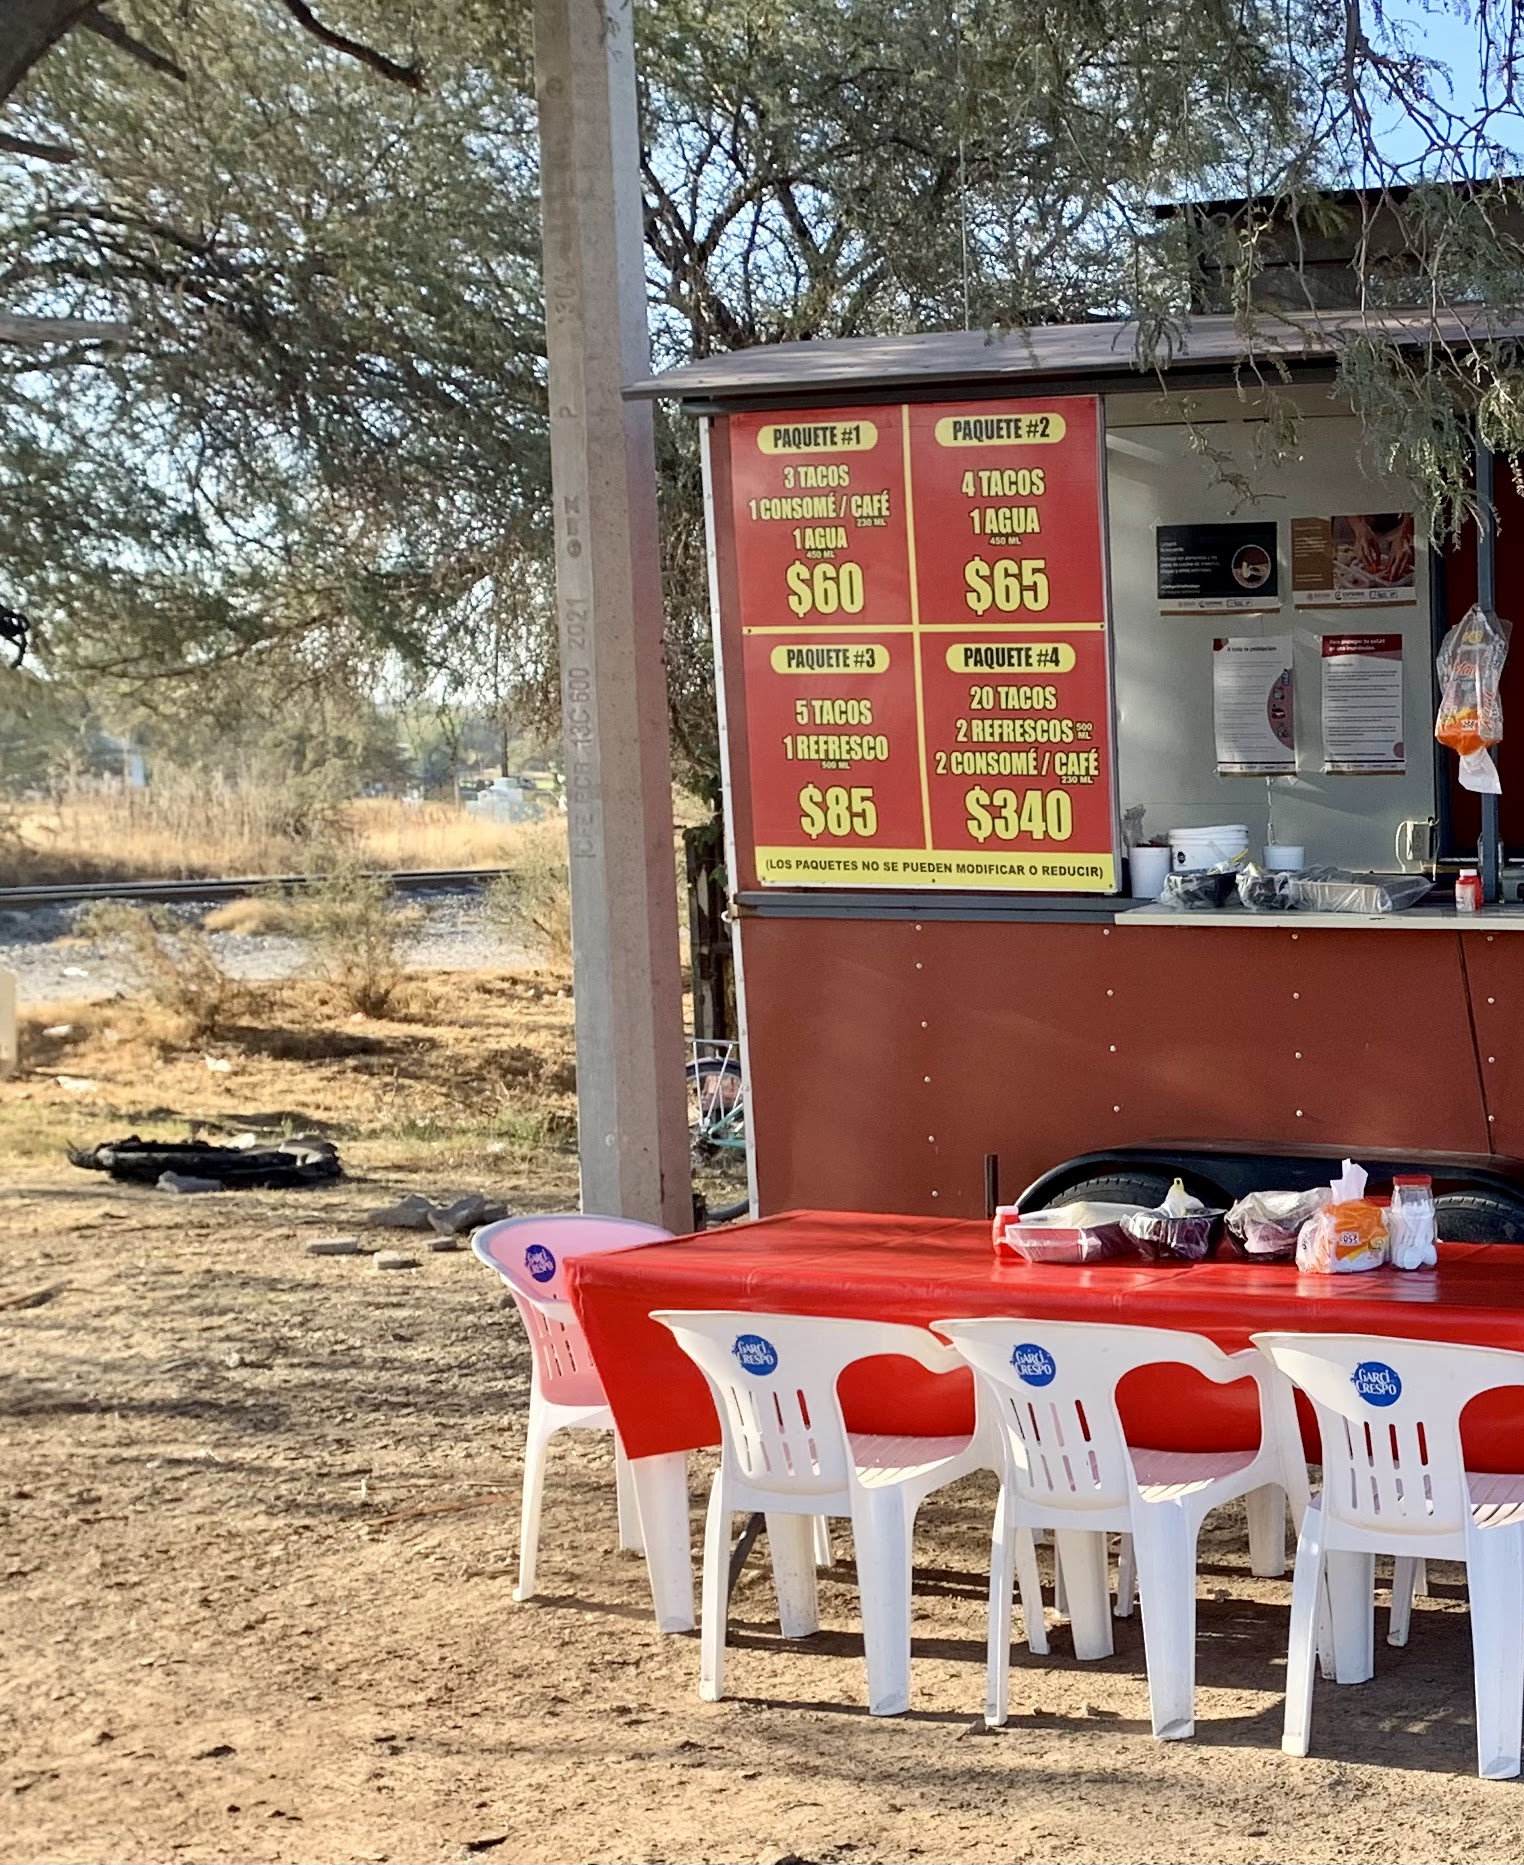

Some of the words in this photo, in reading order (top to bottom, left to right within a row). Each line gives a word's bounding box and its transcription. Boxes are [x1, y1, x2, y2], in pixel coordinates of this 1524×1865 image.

[773, 425, 838, 450] PAQUETE
[840, 424, 861, 446] #1
[952, 417, 1023, 443] PAQUETE
[1025, 416, 1050, 438] #2
[783, 466, 795, 489] 3
[797, 464, 850, 488] TACOS
[961, 471, 976, 497] 4
[978, 468, 1045, 497] TACOS
[748, 499, 757, 521] 1
[759, 492, 837, 520] CONSOMÉ
[839, 495, 847, 518] /
[850, 490, 890, 518] CAFÉ
[873, 517, 887, 526] ML
[969, 508, 981, 534] 1
[984, 507, 1040, 534] AGUA
[792, 528, 802, 550] 1
[804, 526, 848, 550] AGUA
[989, 536, 1007, 546] 450
[1007, 536, 1022, 545] ML
[806, 550, 822, 559] 450
[823, 550, 835, 559] ML
[786, 560, 864, 618] $60
[964, 556, 1049, 616] $65
[786, 648, 851, 671] PAQUETE
[853, 647, 876, 669] #3
[963, 646, 1033, 670] PAQUETE
[1036, 646, 1061, 668] #4
[970, 686, 994, 710] 20
[997, 686, 1057, 710] TACOS
[795, 700, 809, 725] 5
[811, 699, 873, 725] TACOS
[956, 718, 968, 742] 2
[971, 719, 1074, 743] REFRESCOS
[1077, 731, 1092, 740] ML
[783, 735, 793, 760] 1
[796, 735, 889, 761] REFRESCO
[935, 751, 947, 774] 2
[950, 748, 1038, 775] CONSOMÉ
[1041, 752, 1051, 776] /
[1054, 748, 1099, 776] CAFÉ
[1061, 775, 1078, 784] 230
[1079, 775, 1094, 784] ML
[799, 783, 877, 840] $85
[965, 785, 1072, 843] $340
[765, 858, 793, 872] (LOS
[795, 859, 859, 871] PAQUETES
[861, 860, 880, 872] NO
[883, 861, 899, 872] SE
[902, 861, 953, 874] PUEDEN
[955, 863, 1026, 876] MODIFICAR
[1028, 865, 1038, 876] O
[1041, 865, 1104, 880] REDUCIR)
[737, 1352, 774, 1365] CRESPO
[1015, 1362, 1052, 1375] CRESPO
[1356, 1380, 1397, 1395] CRESPO
